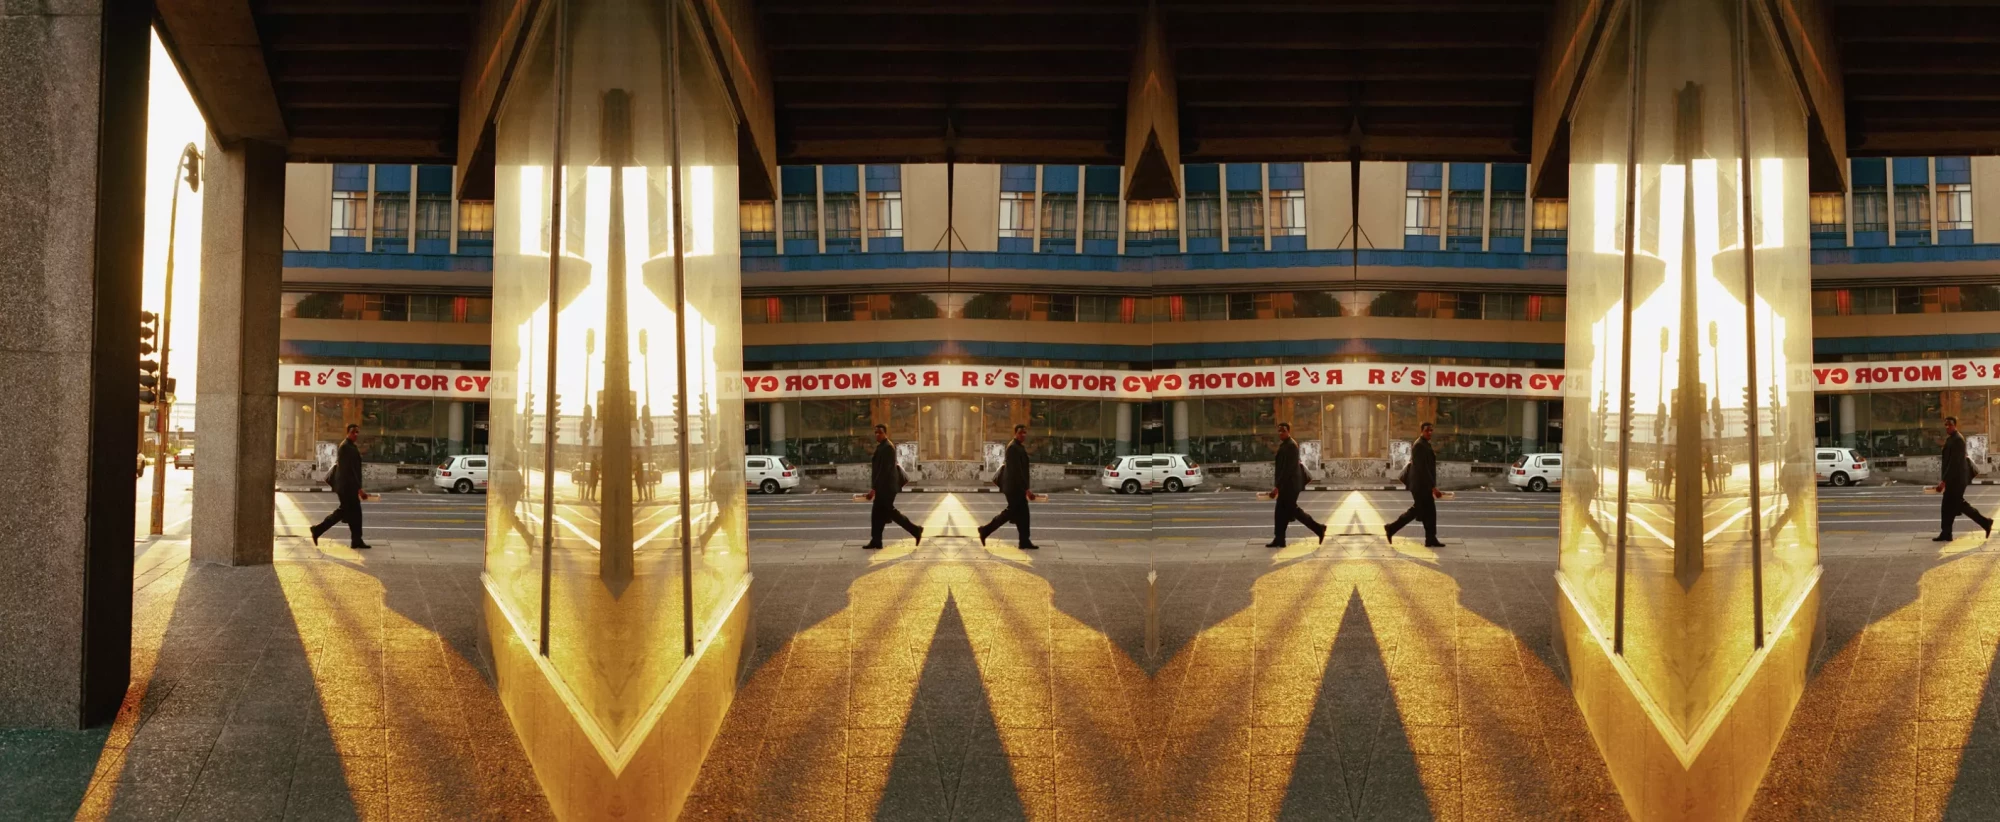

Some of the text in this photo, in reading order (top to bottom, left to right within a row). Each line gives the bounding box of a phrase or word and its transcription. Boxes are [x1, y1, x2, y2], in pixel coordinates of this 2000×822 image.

[294, 370, 311, 386] R
[336, 371, 352, 388] S
[361, 372, 449, 391] MOTOR
[961, 371, 979, 387] R
[1004, 371, 1020, 388] S
[1029, 373, 1116, 392] MOTOR
[1368, 368, 1385, 385] R
[1410, 369, 1426, 386] S
[1435, 370, 1523, 390] MOTOR
